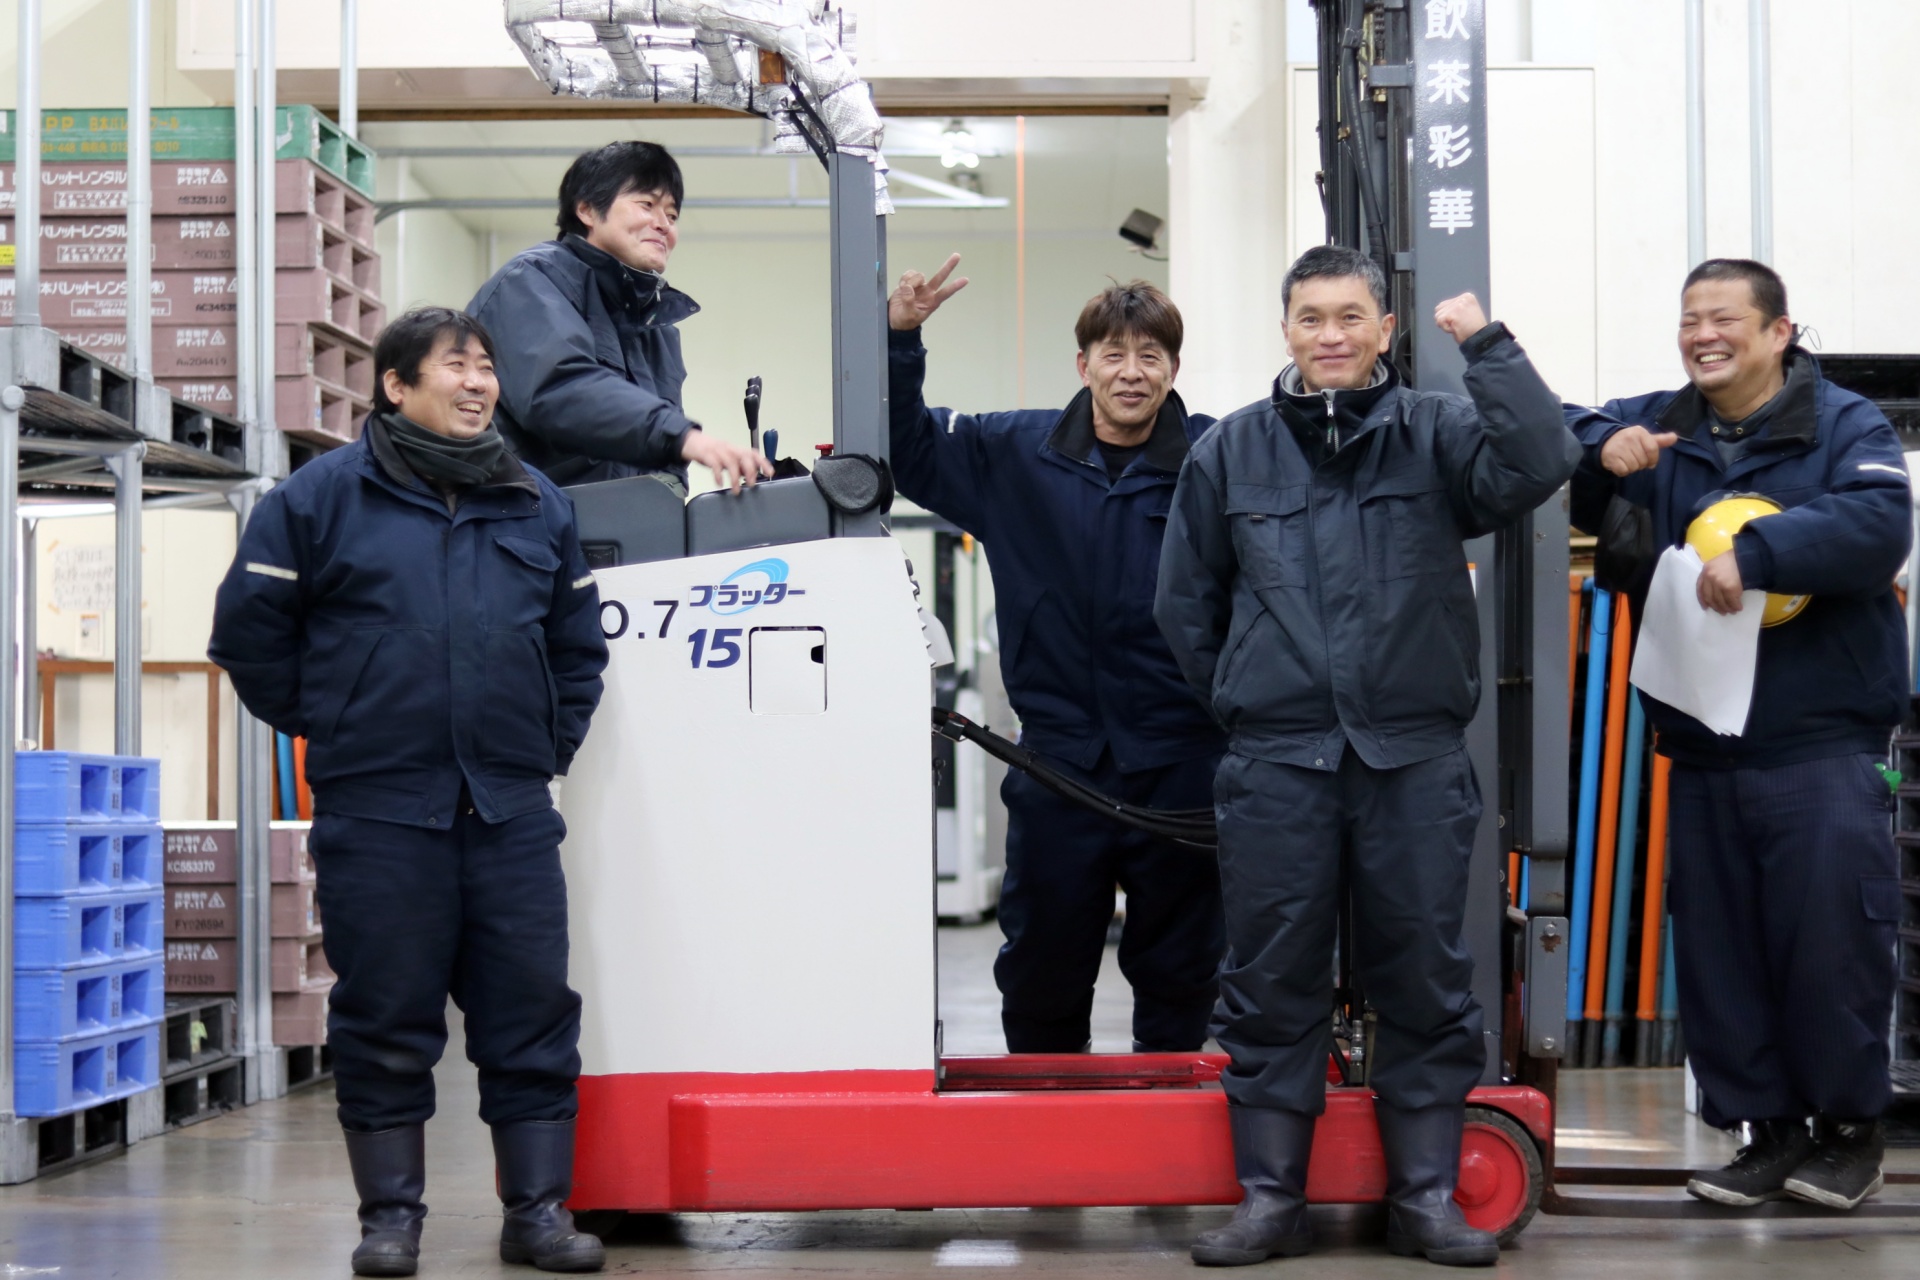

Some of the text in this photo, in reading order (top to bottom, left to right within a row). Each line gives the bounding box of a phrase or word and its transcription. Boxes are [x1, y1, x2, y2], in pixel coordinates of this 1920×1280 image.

[1425, 0, 1474, 234] 飲茶彩華
[689, 584, 806, 607] プラッター
[688, 628, 743, 668] 15
